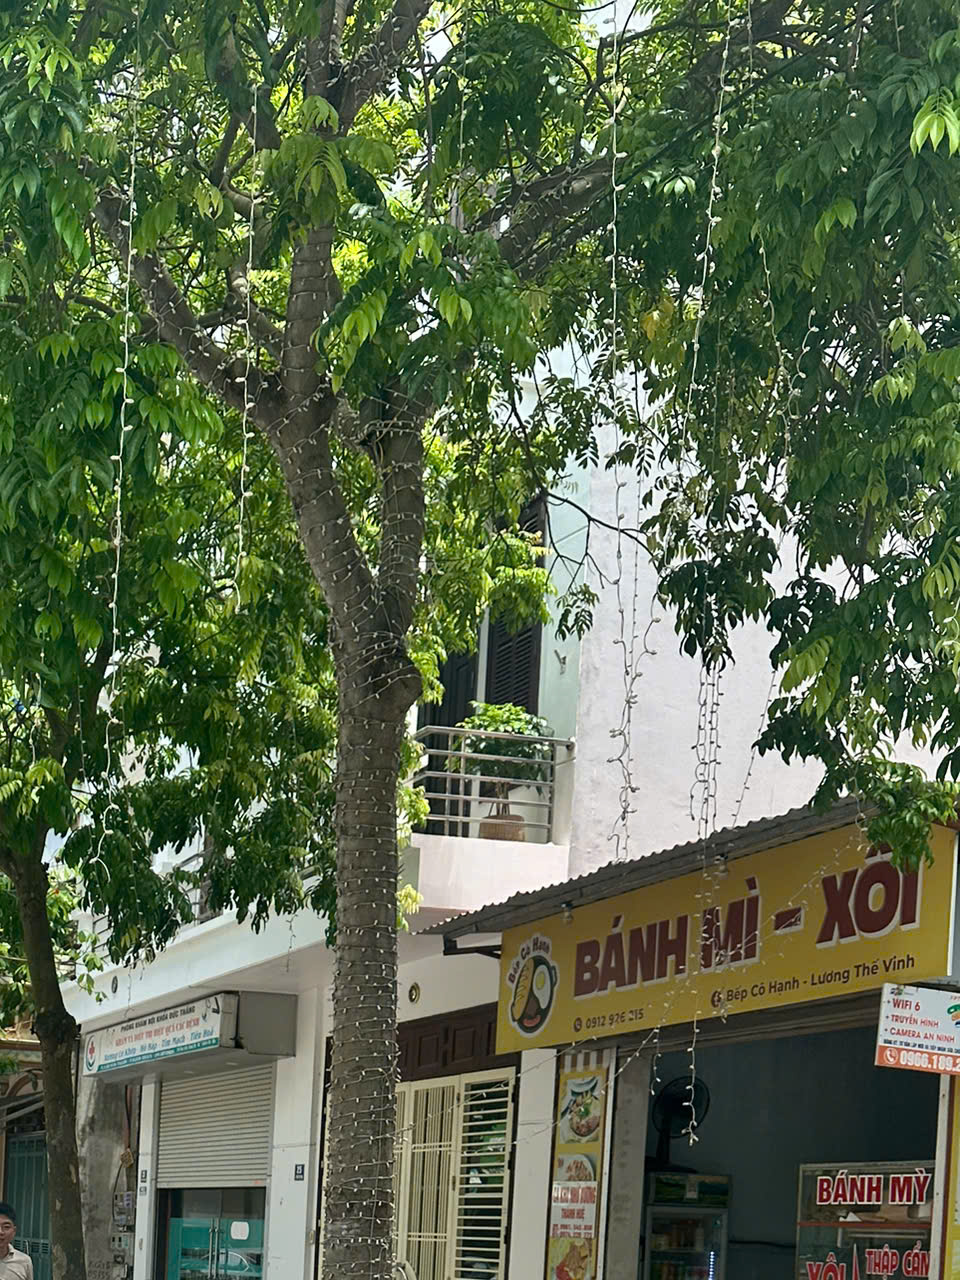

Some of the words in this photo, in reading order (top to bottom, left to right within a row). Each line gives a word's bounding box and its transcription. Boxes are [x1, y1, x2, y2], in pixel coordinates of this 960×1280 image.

[574, 914, 688, 997] BÁNH
[700, 876, 760, 969] MÌ
[816, 842, 921, 945] XÔI
[726, 986, 747, 1002] Bếp
[751, 982, 765, 997] Cô
[769, 976, 799, 995] Hạnh
[810, 968, 850, 986] Lương
[854, 960, 878, 977] Thế
[585, 1015, 607, 1029] 0912
[892, 998, 912, 1011] WIFI
[914, 1001, 920, 1011] 6
[889, 1027, 921, 1039] CAMERA
[924, 1032, 934, 1041] AN
[936, 1034, 955, 1043] NINH
[816, 1169, 883, 1205] BÁNH
[888, 1168, 932, 1205] MỲ
[865, 1244, 900, 1280] THẬP
